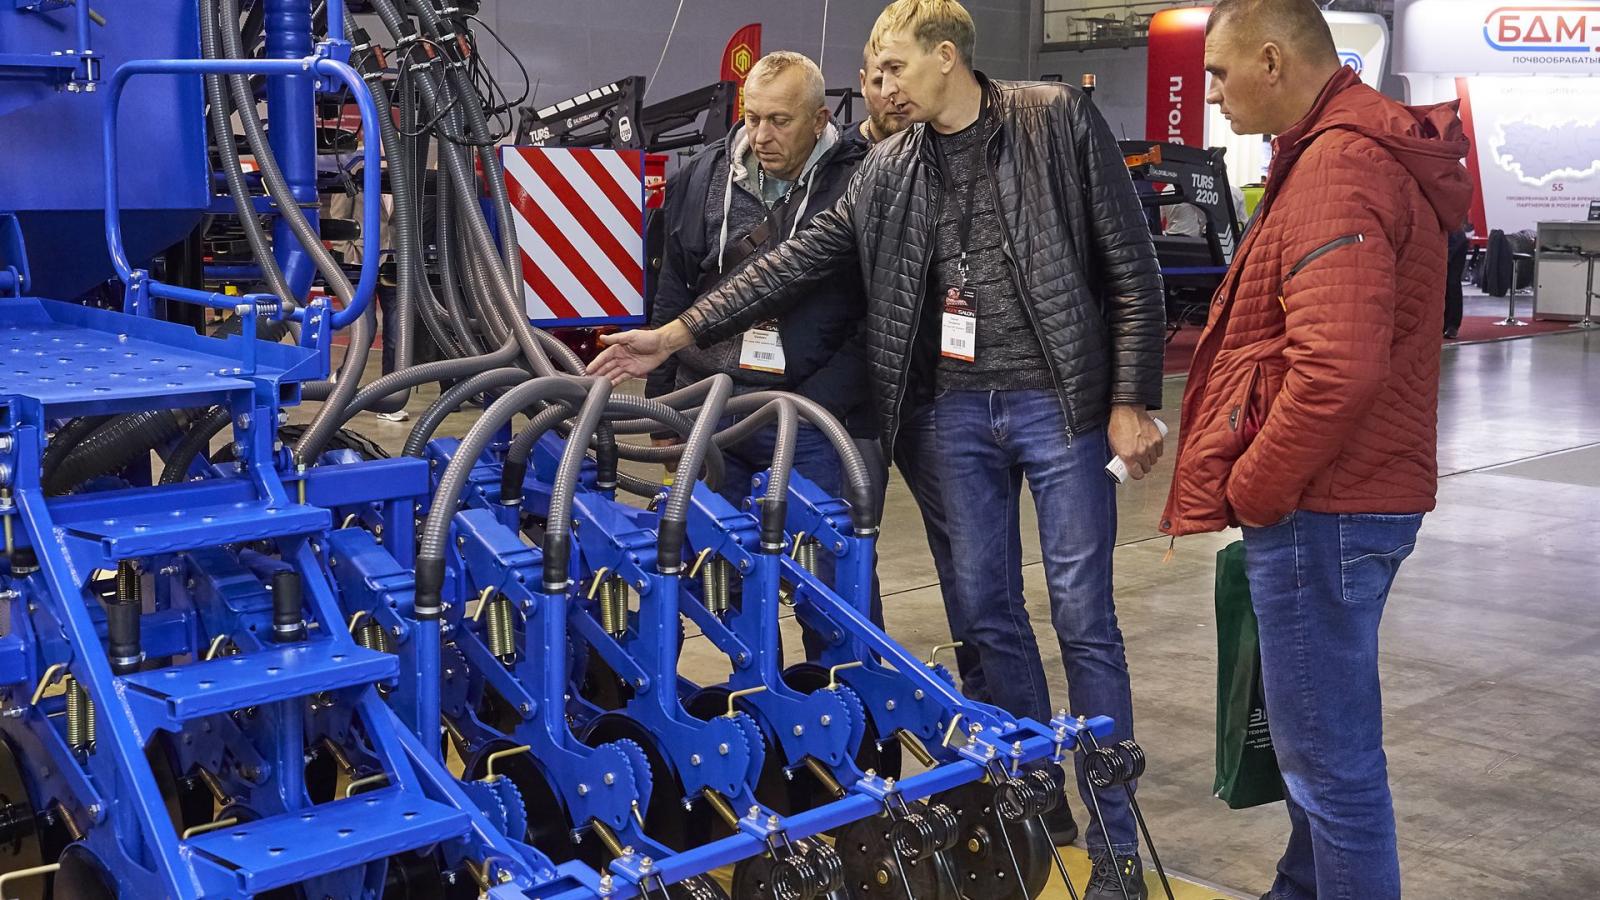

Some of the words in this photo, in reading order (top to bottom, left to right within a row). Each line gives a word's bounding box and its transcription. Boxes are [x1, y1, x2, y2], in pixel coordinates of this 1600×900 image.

[1192, 173, 1214, 189] TURS
[1552, 183, 1564, 191] 55
[1195, 189, 1219, 205] 2200
